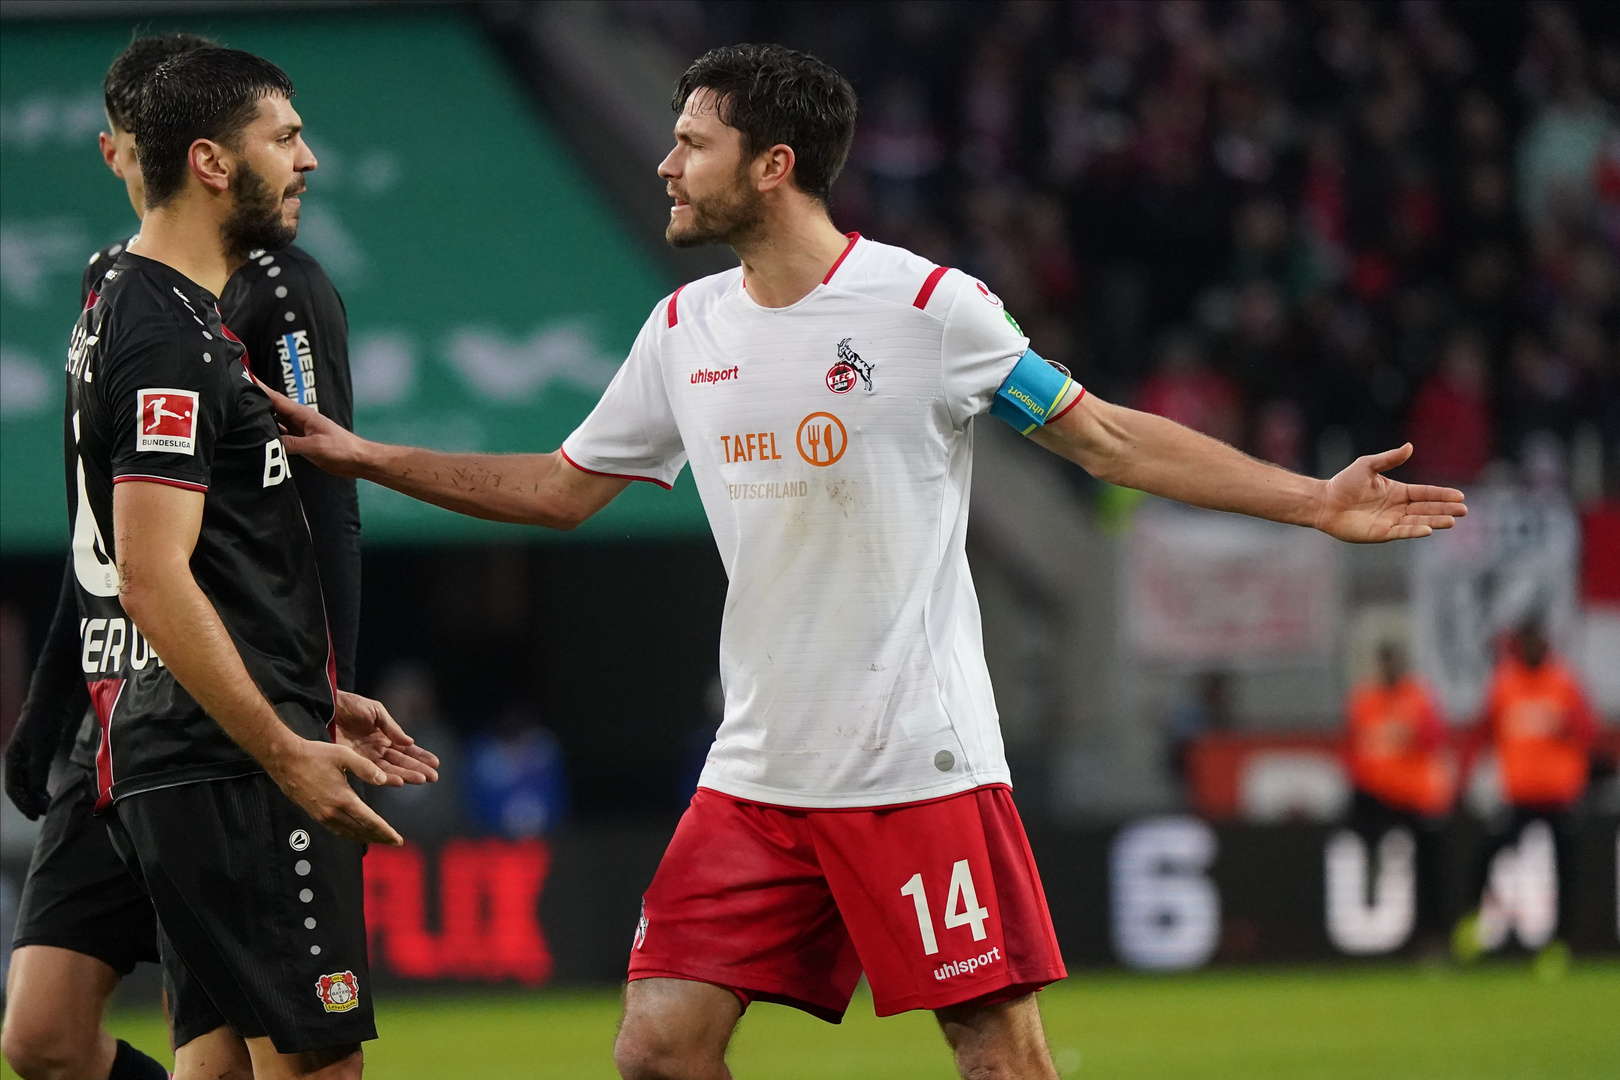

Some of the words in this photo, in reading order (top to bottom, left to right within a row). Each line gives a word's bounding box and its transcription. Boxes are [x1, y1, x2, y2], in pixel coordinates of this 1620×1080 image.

[690, 366, 739, 385] uhlsport
[1008, 386, 1045, 416] uhlsport
[142, 439, 191, 449] BUNDESLIGA
[720, 432, 782, 463] TAFEL
[262, 438, 292, 488] B
[728, 481, 808, 500] EUTSCHLAND
[900, 859, 989, 956] 14
[933, 946, 1001, 981] uhlsport
